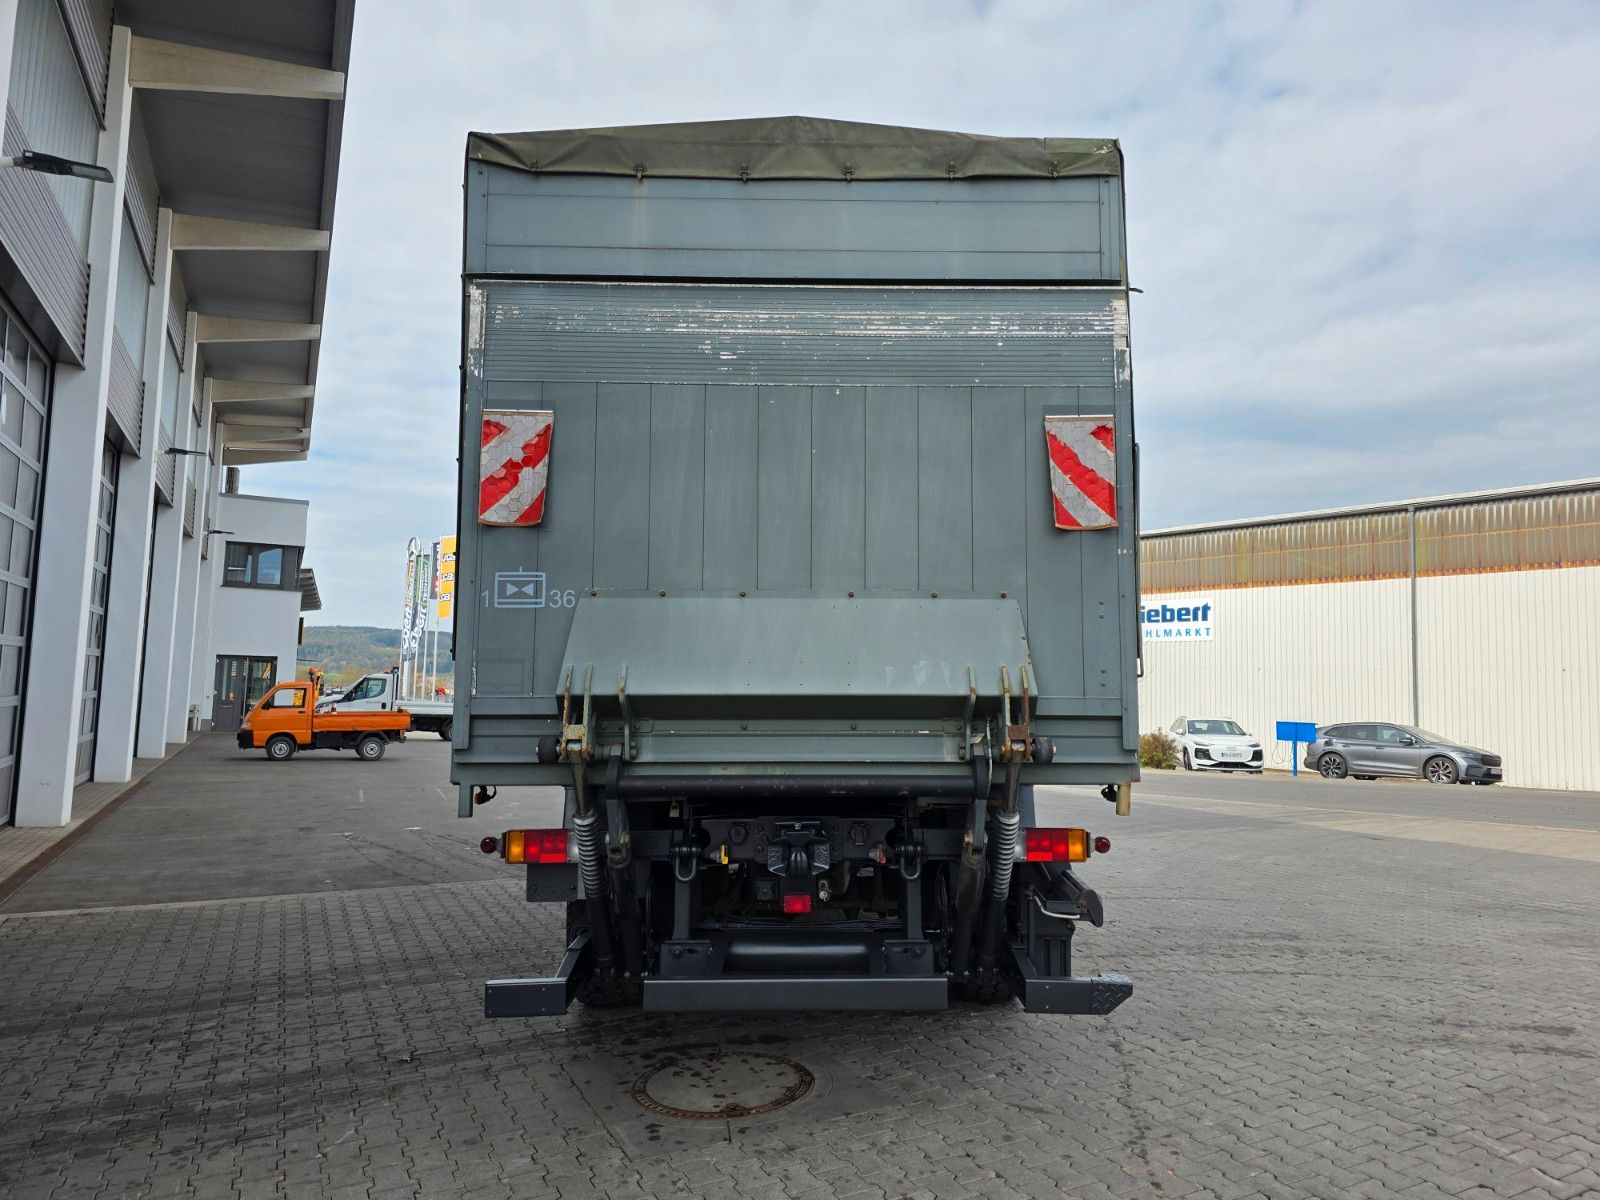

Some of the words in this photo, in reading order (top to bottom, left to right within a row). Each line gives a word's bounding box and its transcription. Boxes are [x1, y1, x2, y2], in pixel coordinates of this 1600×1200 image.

[481, 589, 489, 608] 1
[549, 589, 576, 608] 36
[1140, 602, 1211, 624] iebert
[1145, 627, 1212, 638] HLMARKT
